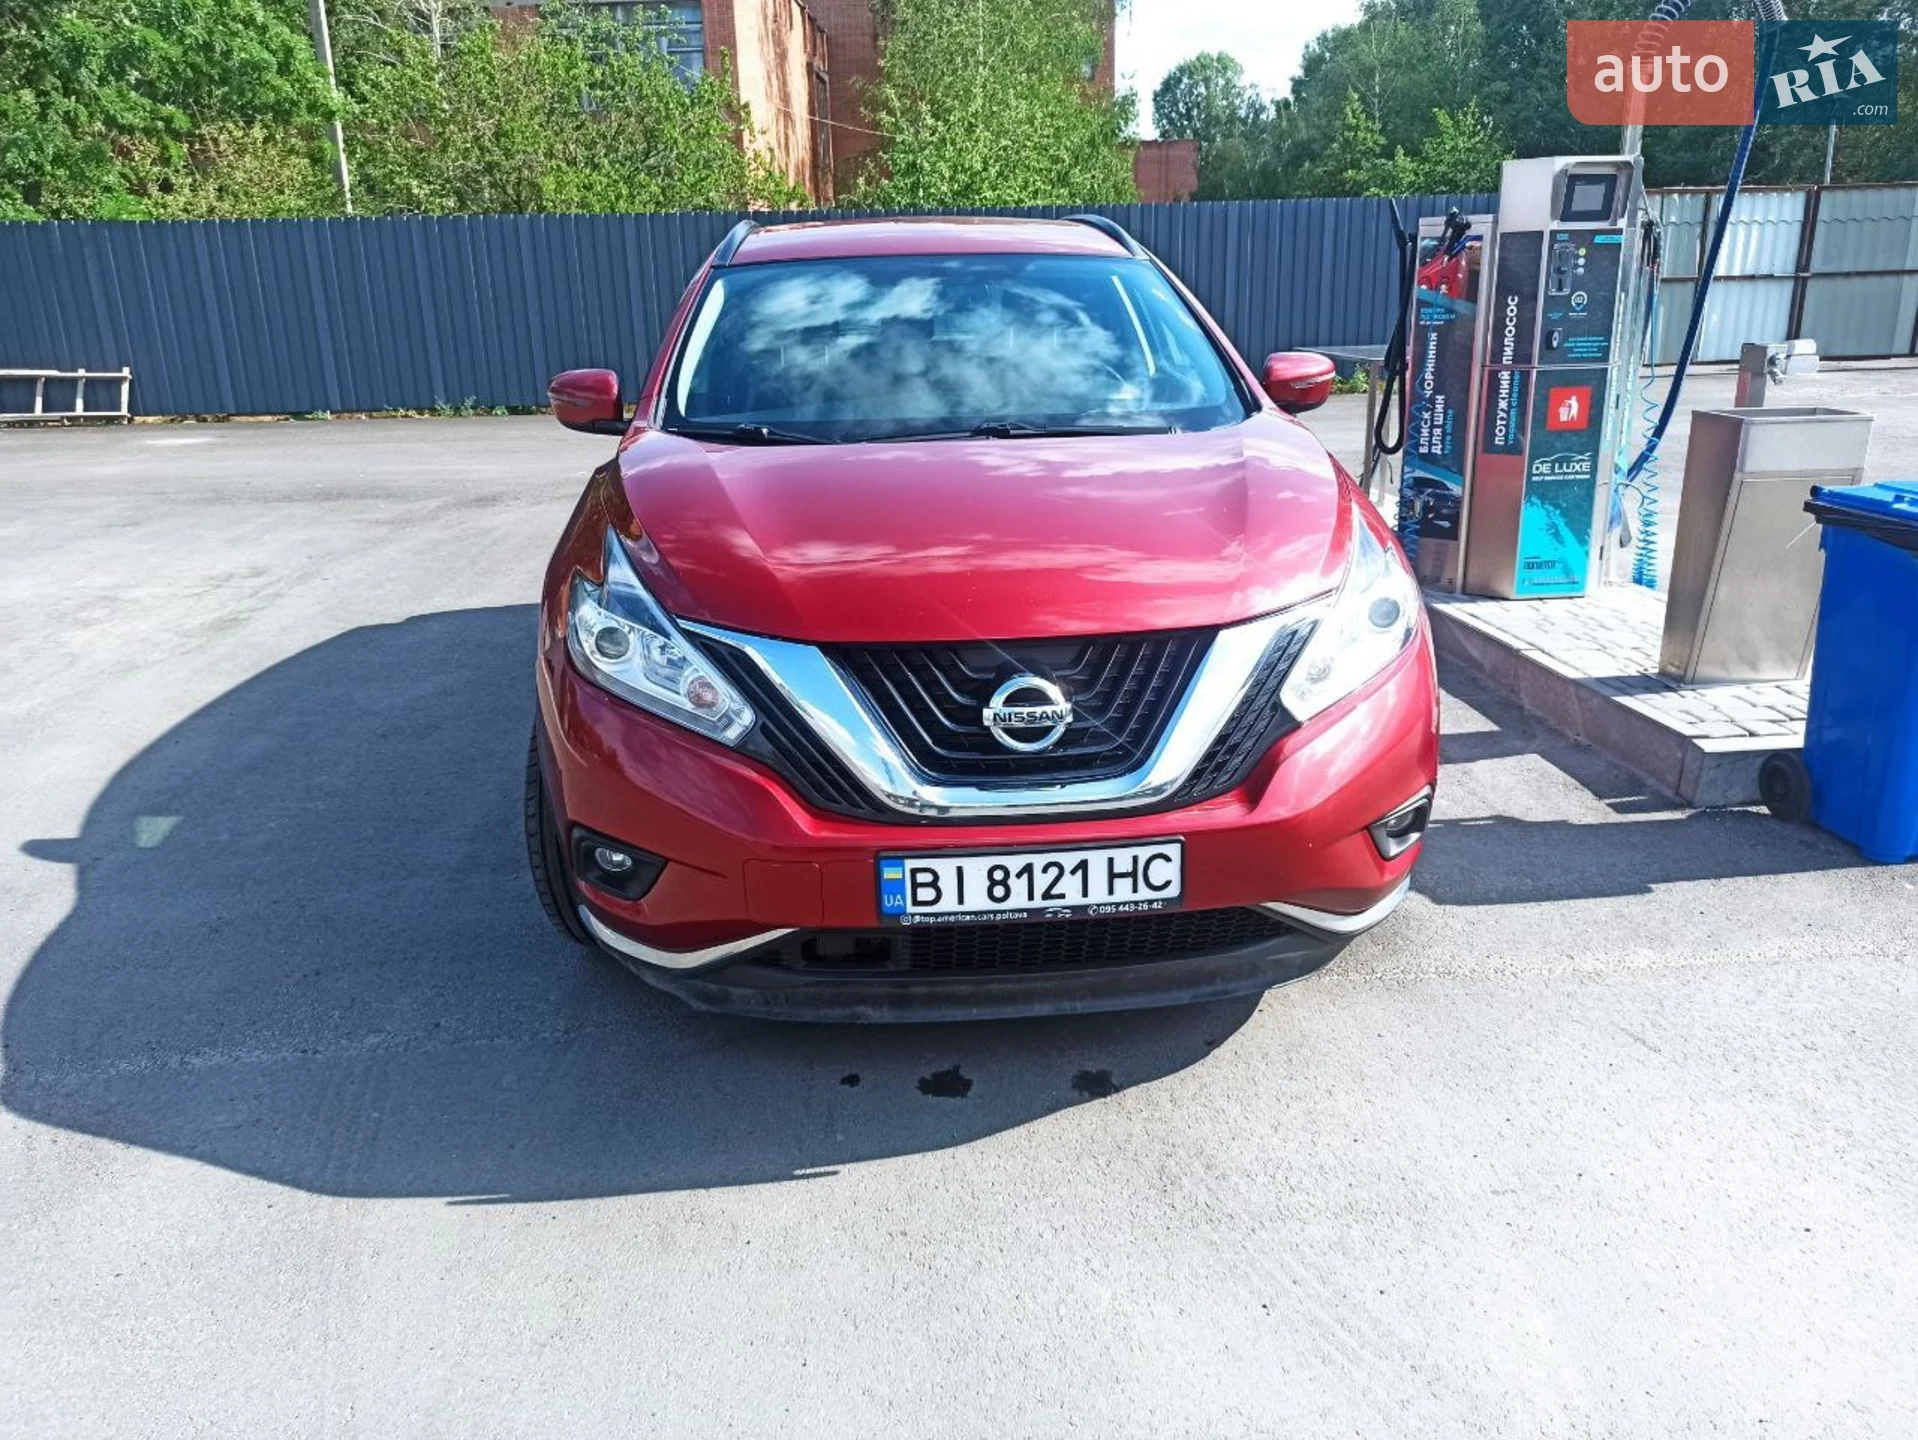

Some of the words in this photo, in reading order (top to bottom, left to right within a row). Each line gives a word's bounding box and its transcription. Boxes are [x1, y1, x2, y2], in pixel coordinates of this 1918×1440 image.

[1495, 371, 1511, 445] ПОТУЖНИЙ
[1503, 295, 1518, 365] ПИЛОСОС
[1434, 395, 1445, 424] ШИН
[1419, 411, 1432, 453] БЛИСК
[1432, 427, 1444, 454] ДЛЯ
[1532, 462, 1551, 474] DE
[1555, 461, 1591, 473] LUXE
[993, 710, 1064, 723] NISSAN
[987, 858, 1088, 904] 8121
[1107, 852, 1173, 896] HC
[884, 894, 905, 907] UA
[1099, 906, 1116, 914] 095
